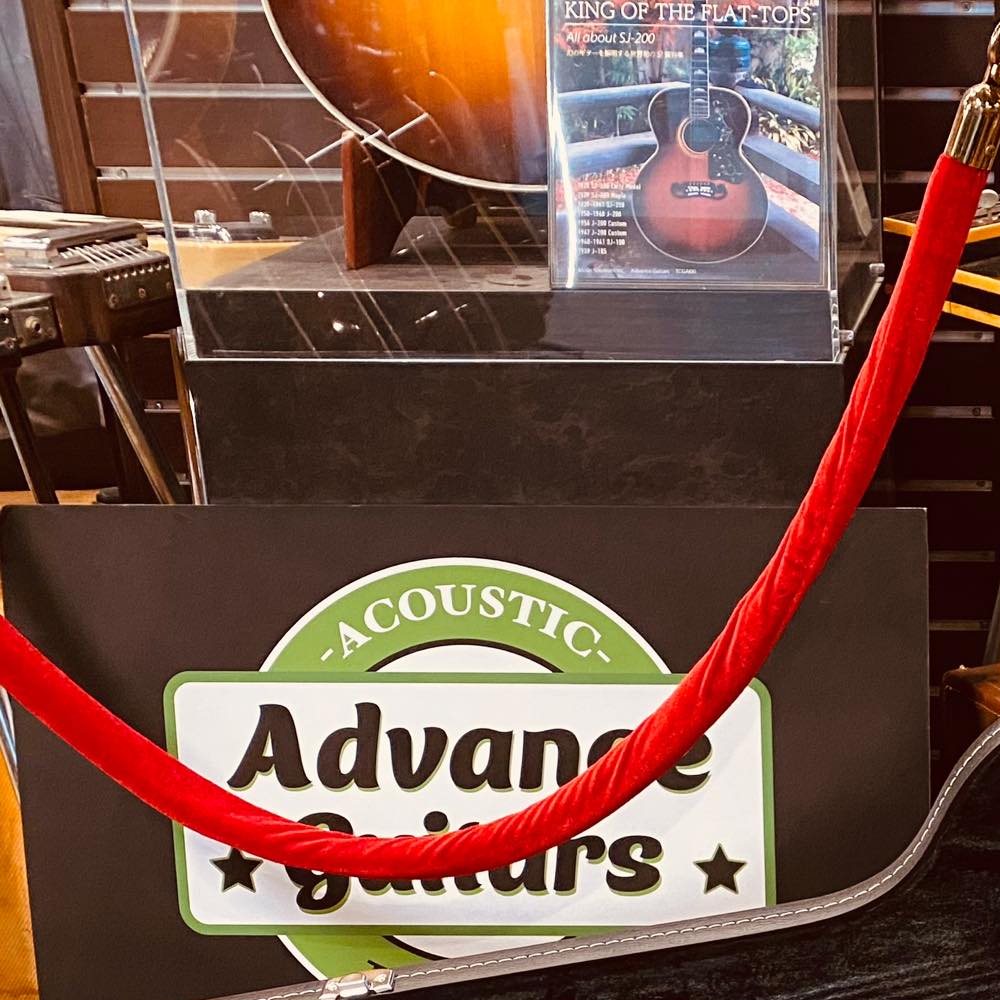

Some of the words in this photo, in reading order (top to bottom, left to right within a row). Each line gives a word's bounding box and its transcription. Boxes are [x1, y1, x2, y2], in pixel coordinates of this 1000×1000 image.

[564, 1, 615, 19] KING
[621, 2, 649, 19] OF
[655, 3, 696, 21] THE
[701, 4, 811, 24] FLAT-TOPS
[566, 31, 581, 43] All
[583, 31, 617, 43] about
[619, 32, 656, 44] SJ-200
[285, 811, 663, 914] Giars
